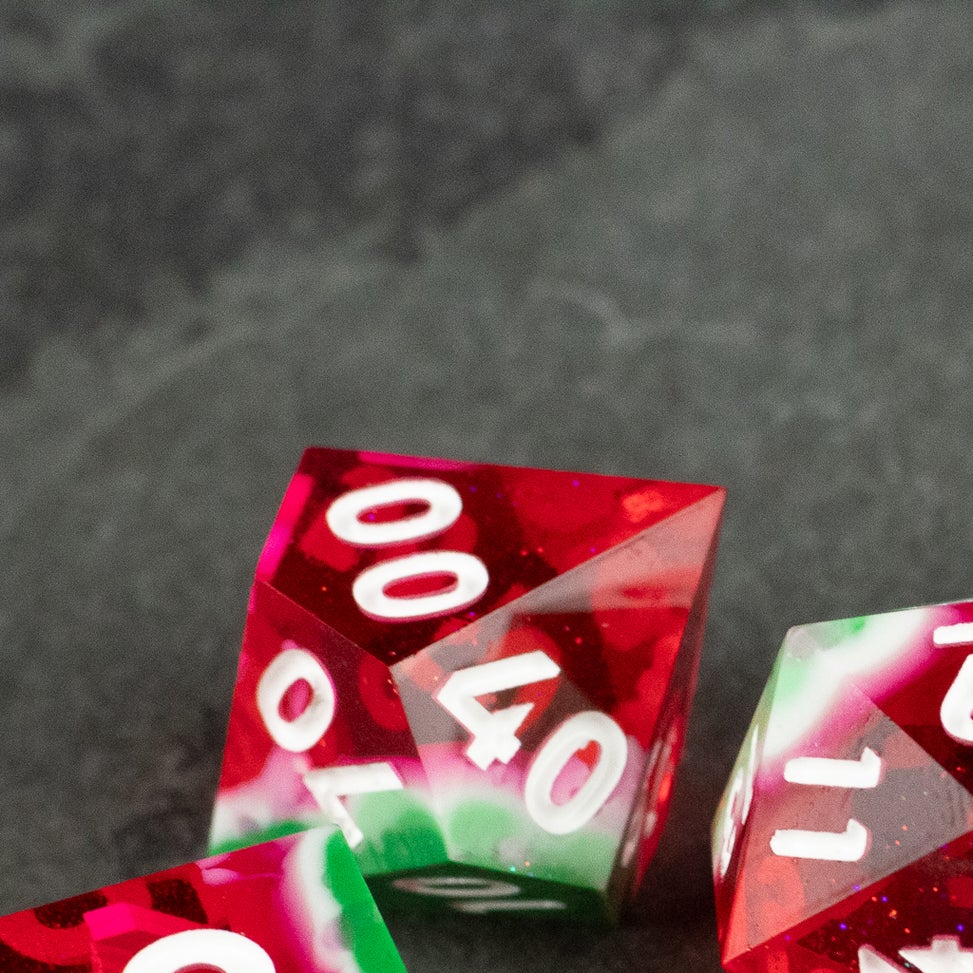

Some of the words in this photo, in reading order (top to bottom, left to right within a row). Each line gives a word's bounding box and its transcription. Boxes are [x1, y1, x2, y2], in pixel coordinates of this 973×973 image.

[326, 477, 489, 622] 00
[437, 650, 628, 836] 40
[770, 746, 883, 861] 11
